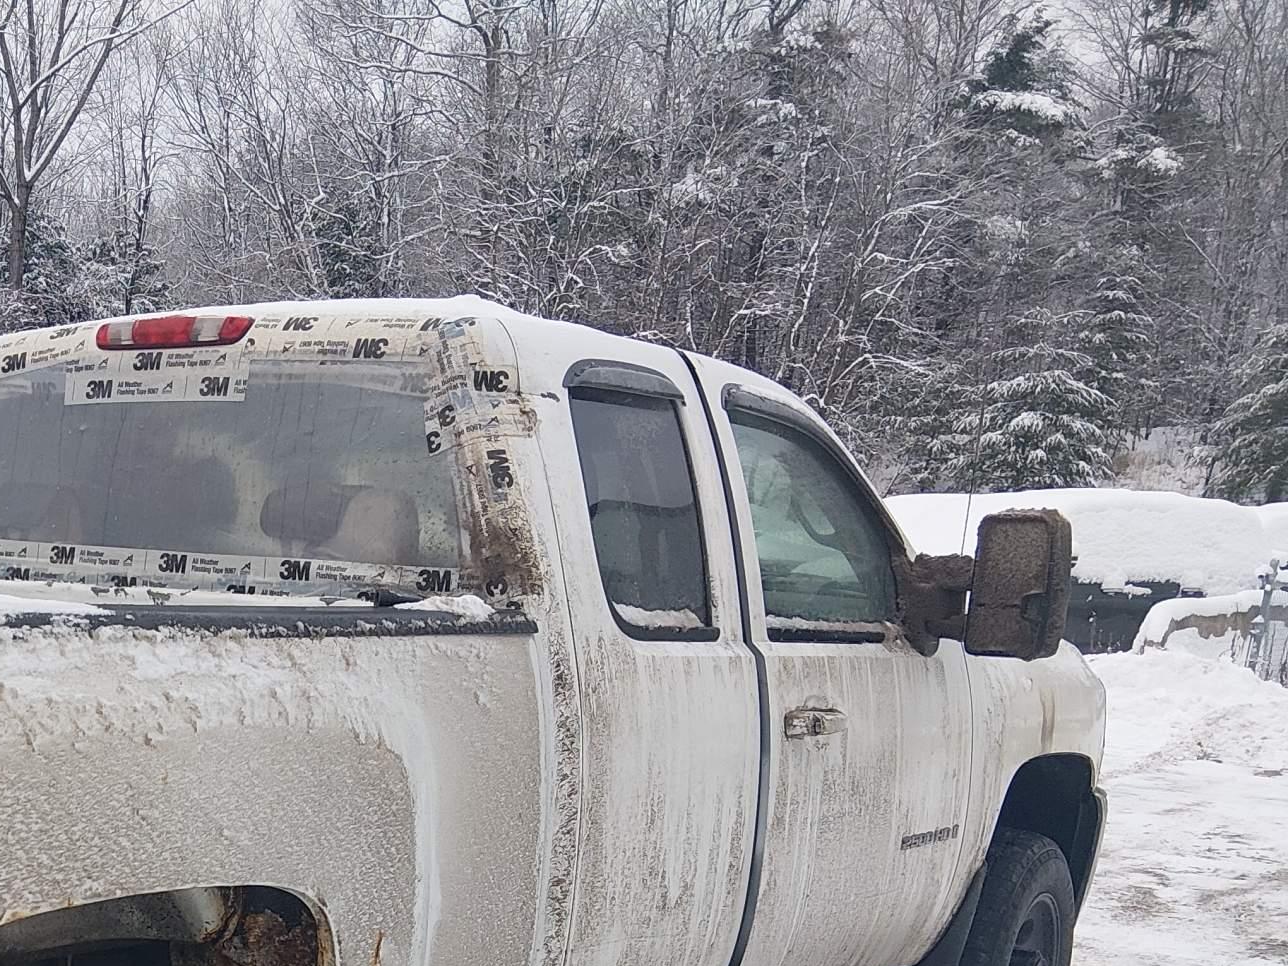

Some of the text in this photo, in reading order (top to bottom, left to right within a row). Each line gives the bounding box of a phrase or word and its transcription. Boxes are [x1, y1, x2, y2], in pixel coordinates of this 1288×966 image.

[283, 317, 319, 331] 3M
[353, 338, 389, 359] 3M
[1, 353, 27, 373] 3M
[133, 351, 164, 371] 3M
[86, 380, 113, 399] 3M
[199, 376, 230, 397] 3M
[474, 371, 509, 393] 3M
[50, 546, 76, 565] 3M
[158, 553, 187, 574] 3M
[6, 567, 30, 581] 3M
[279, 560, 311, 581] 3M
[316, 571, 337, 581] Flashing
[338, 573, 351, 581] Tape
[416, 569, 452, 592] 3M
